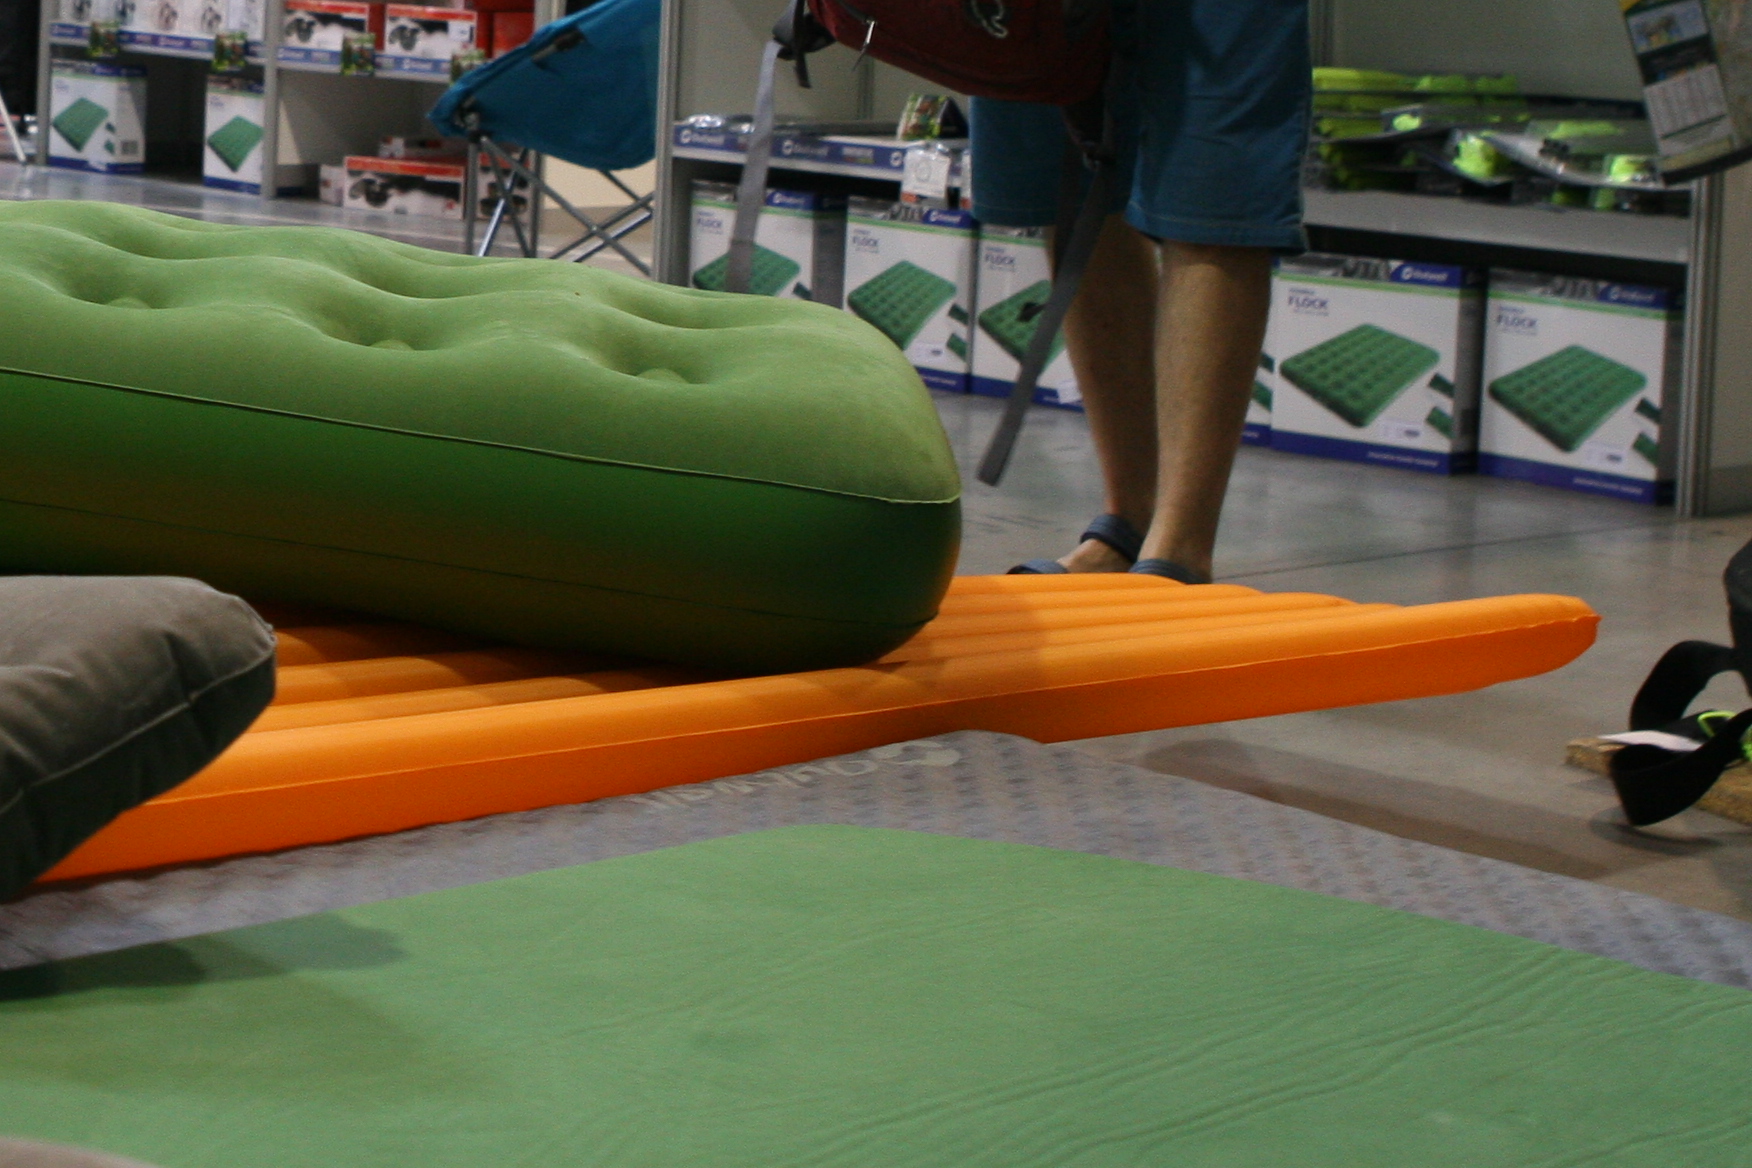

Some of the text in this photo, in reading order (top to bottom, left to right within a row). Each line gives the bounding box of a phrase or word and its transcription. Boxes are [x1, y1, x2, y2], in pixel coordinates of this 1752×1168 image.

[984, 253, 1016, 266] FLOCK
[1288, 295, 1330, 310] FLOCK
[1497, 314, 1537, 329] FLOCK
